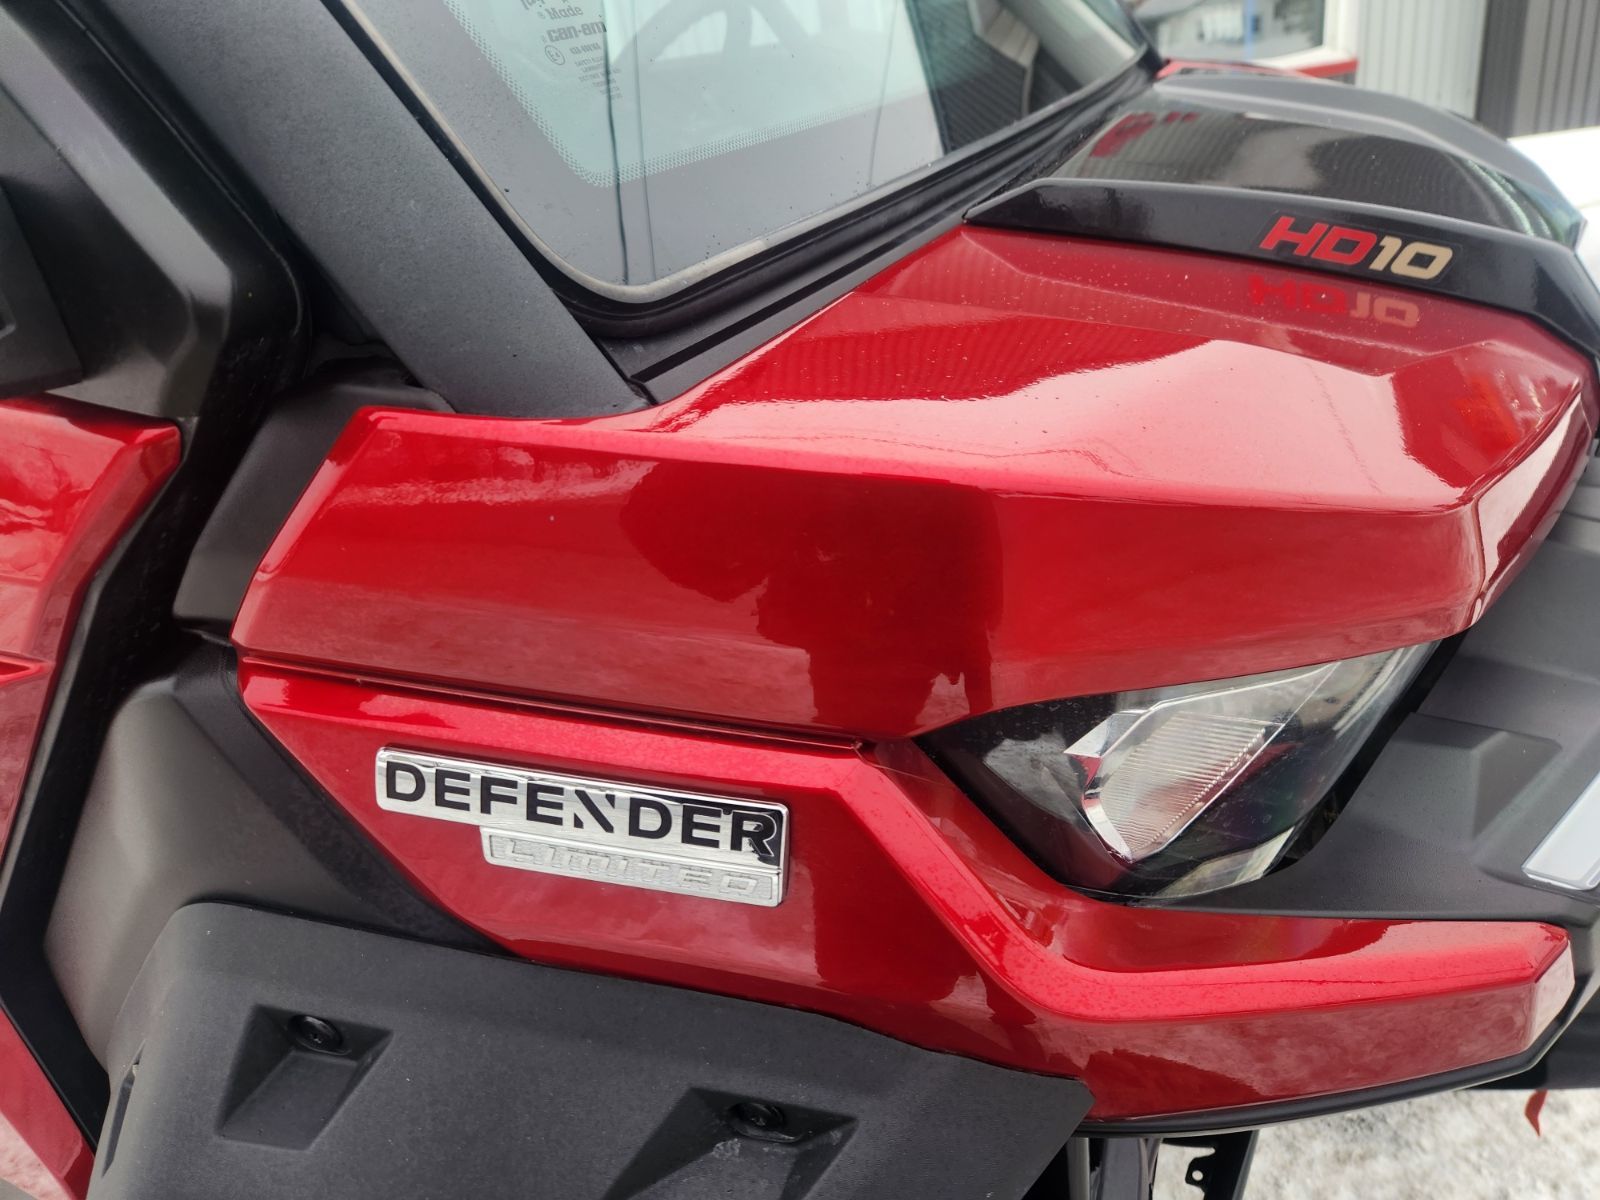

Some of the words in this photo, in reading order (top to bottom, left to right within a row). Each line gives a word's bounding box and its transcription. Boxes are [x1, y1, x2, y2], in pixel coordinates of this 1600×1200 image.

[544, 5, 584, 20] Made
[1259, 215, 1453, 280] HD10
[386, 760, 776, 857] DEFENDER
[504, 839, 758, 895] LIMITED
